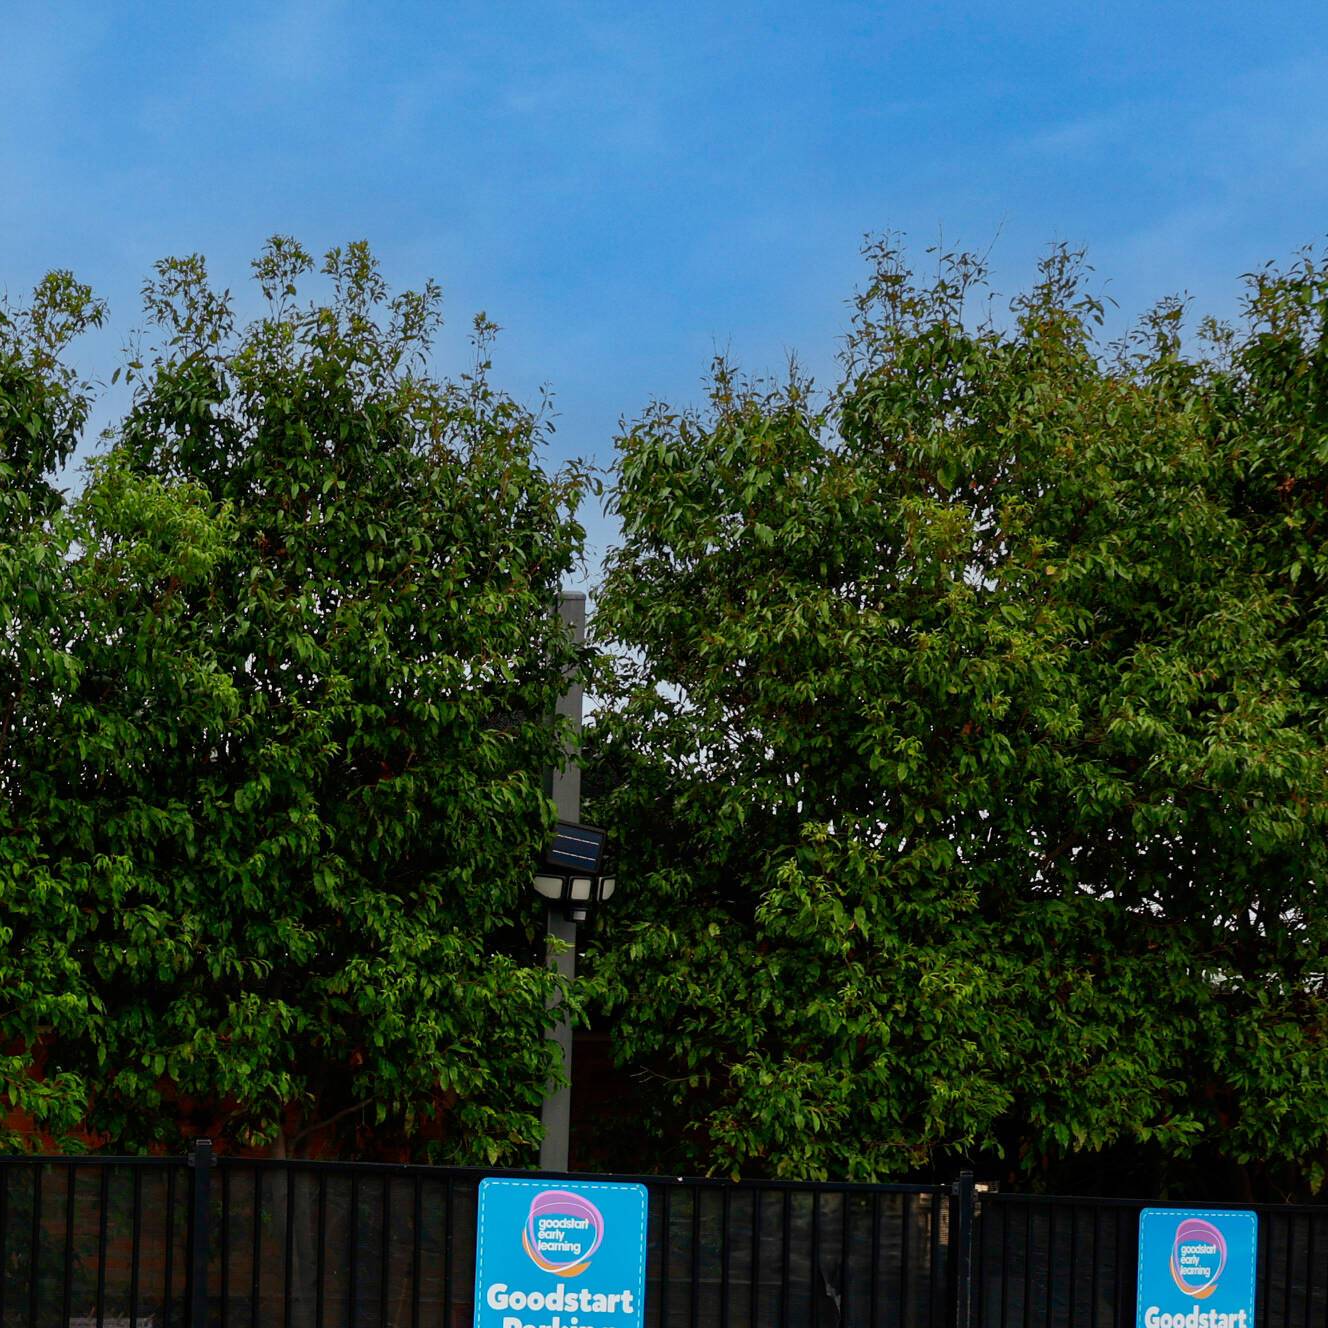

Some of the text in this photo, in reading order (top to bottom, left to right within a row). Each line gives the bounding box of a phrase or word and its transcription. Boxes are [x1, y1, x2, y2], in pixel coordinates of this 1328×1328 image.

[538, 1218, 589, 1231] goodstart
[538, 1229, 565, 1242] early
[538, 1240, 581, 1254] learning
[1180, 1244, 1216, 1256] goodstart
[1180, 1255, 1200, 1266] early
[1180, 1265, 1210, 1278] learning
[486, 1282, 634, 1314] Goodstart
